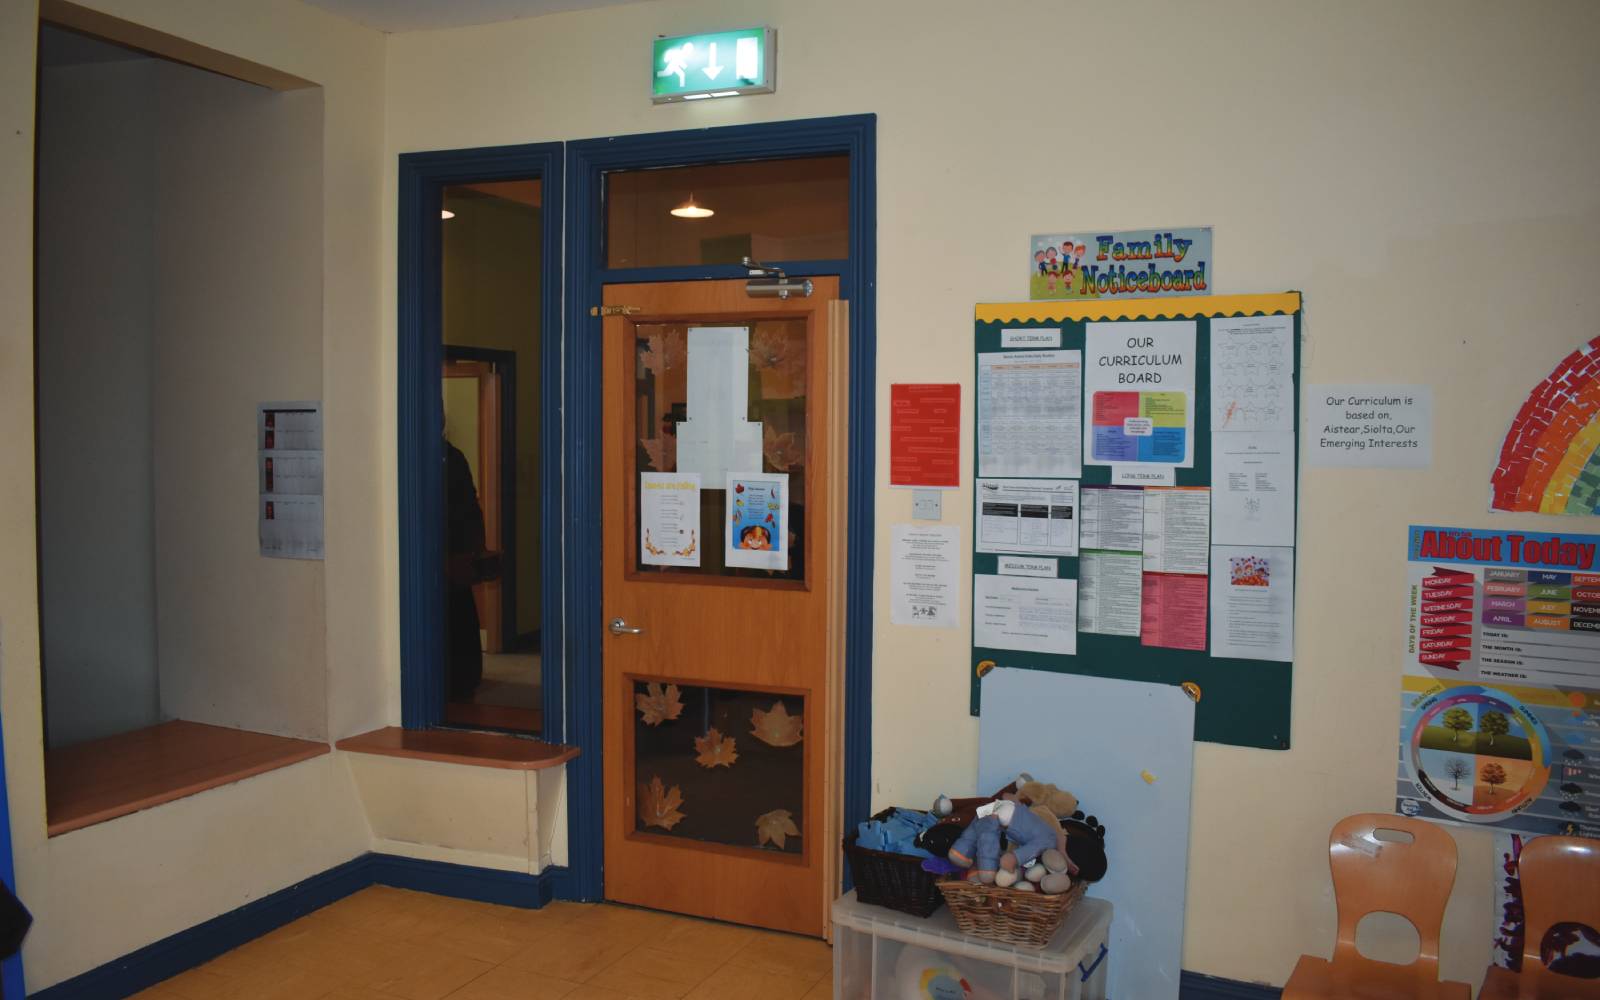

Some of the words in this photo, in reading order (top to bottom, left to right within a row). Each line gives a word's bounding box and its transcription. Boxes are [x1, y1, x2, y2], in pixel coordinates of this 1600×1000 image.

[1096, 233, 1193, 263] Family
[1080, 261, 1207, 294] Noticeboard
[1127, 337, 1154, 348] OUR
[1098, 354, 1182, 366] CURRICULUM
[1118, 372, 1162, 384] BOARD
[1326, 397, 1345, 406] Our
[1348, 396, 1401, 406] Curriculum
[1404, 396, 1413, 405] is
[1345, 411, 1375, 420] based
[1377, 412, 1393, 421] on,
[1320, 438, 1366, 450] Emerging
[1368, 438, 1418, 448] Interests
[1420, 530, 1503, 562] About
[1506, 534, 1596, 570] Today
[1489, 570, 1520, 578] JANUARY
[1424, 578, 1452, 586] MONDAY
[1487, 585, 1520, 593] FEBRUARY
[1424, 590, 1452, 599] TUESDAY
[1424, 603, 1462, 612] WEDNESDAY
[1493, 615, 1512, 623] APRIL
